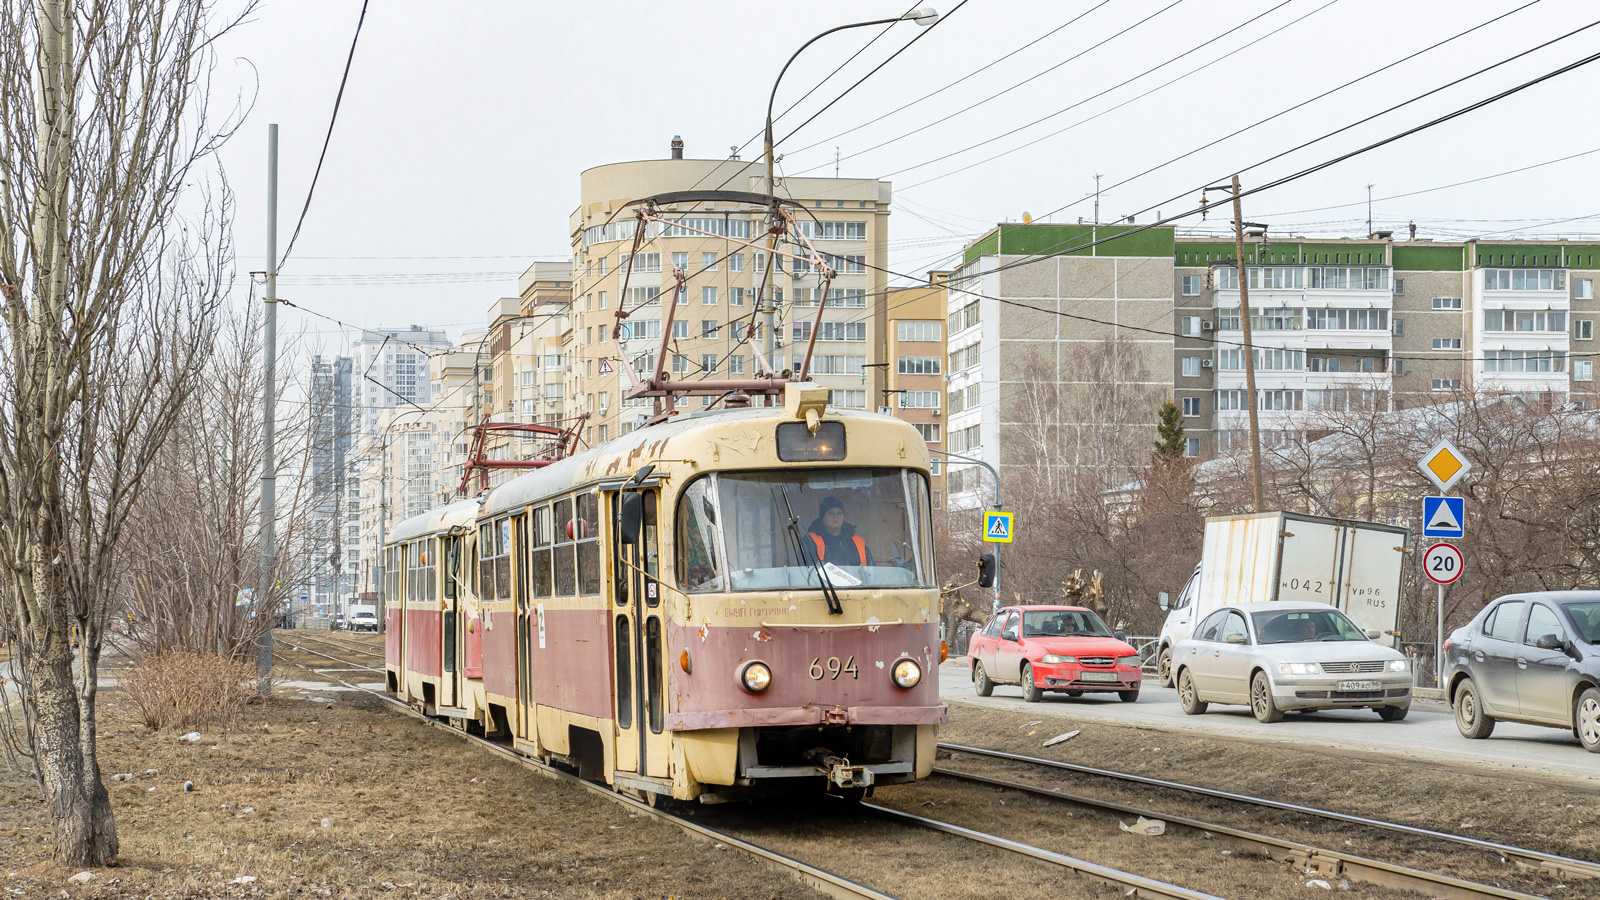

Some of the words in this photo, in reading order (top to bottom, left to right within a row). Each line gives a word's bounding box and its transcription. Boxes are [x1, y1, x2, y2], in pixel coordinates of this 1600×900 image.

[1433, 556, 1454, 571] 20
[1366, 598, 1386, 608] RUS
[809, 655, 859, 681] 694
